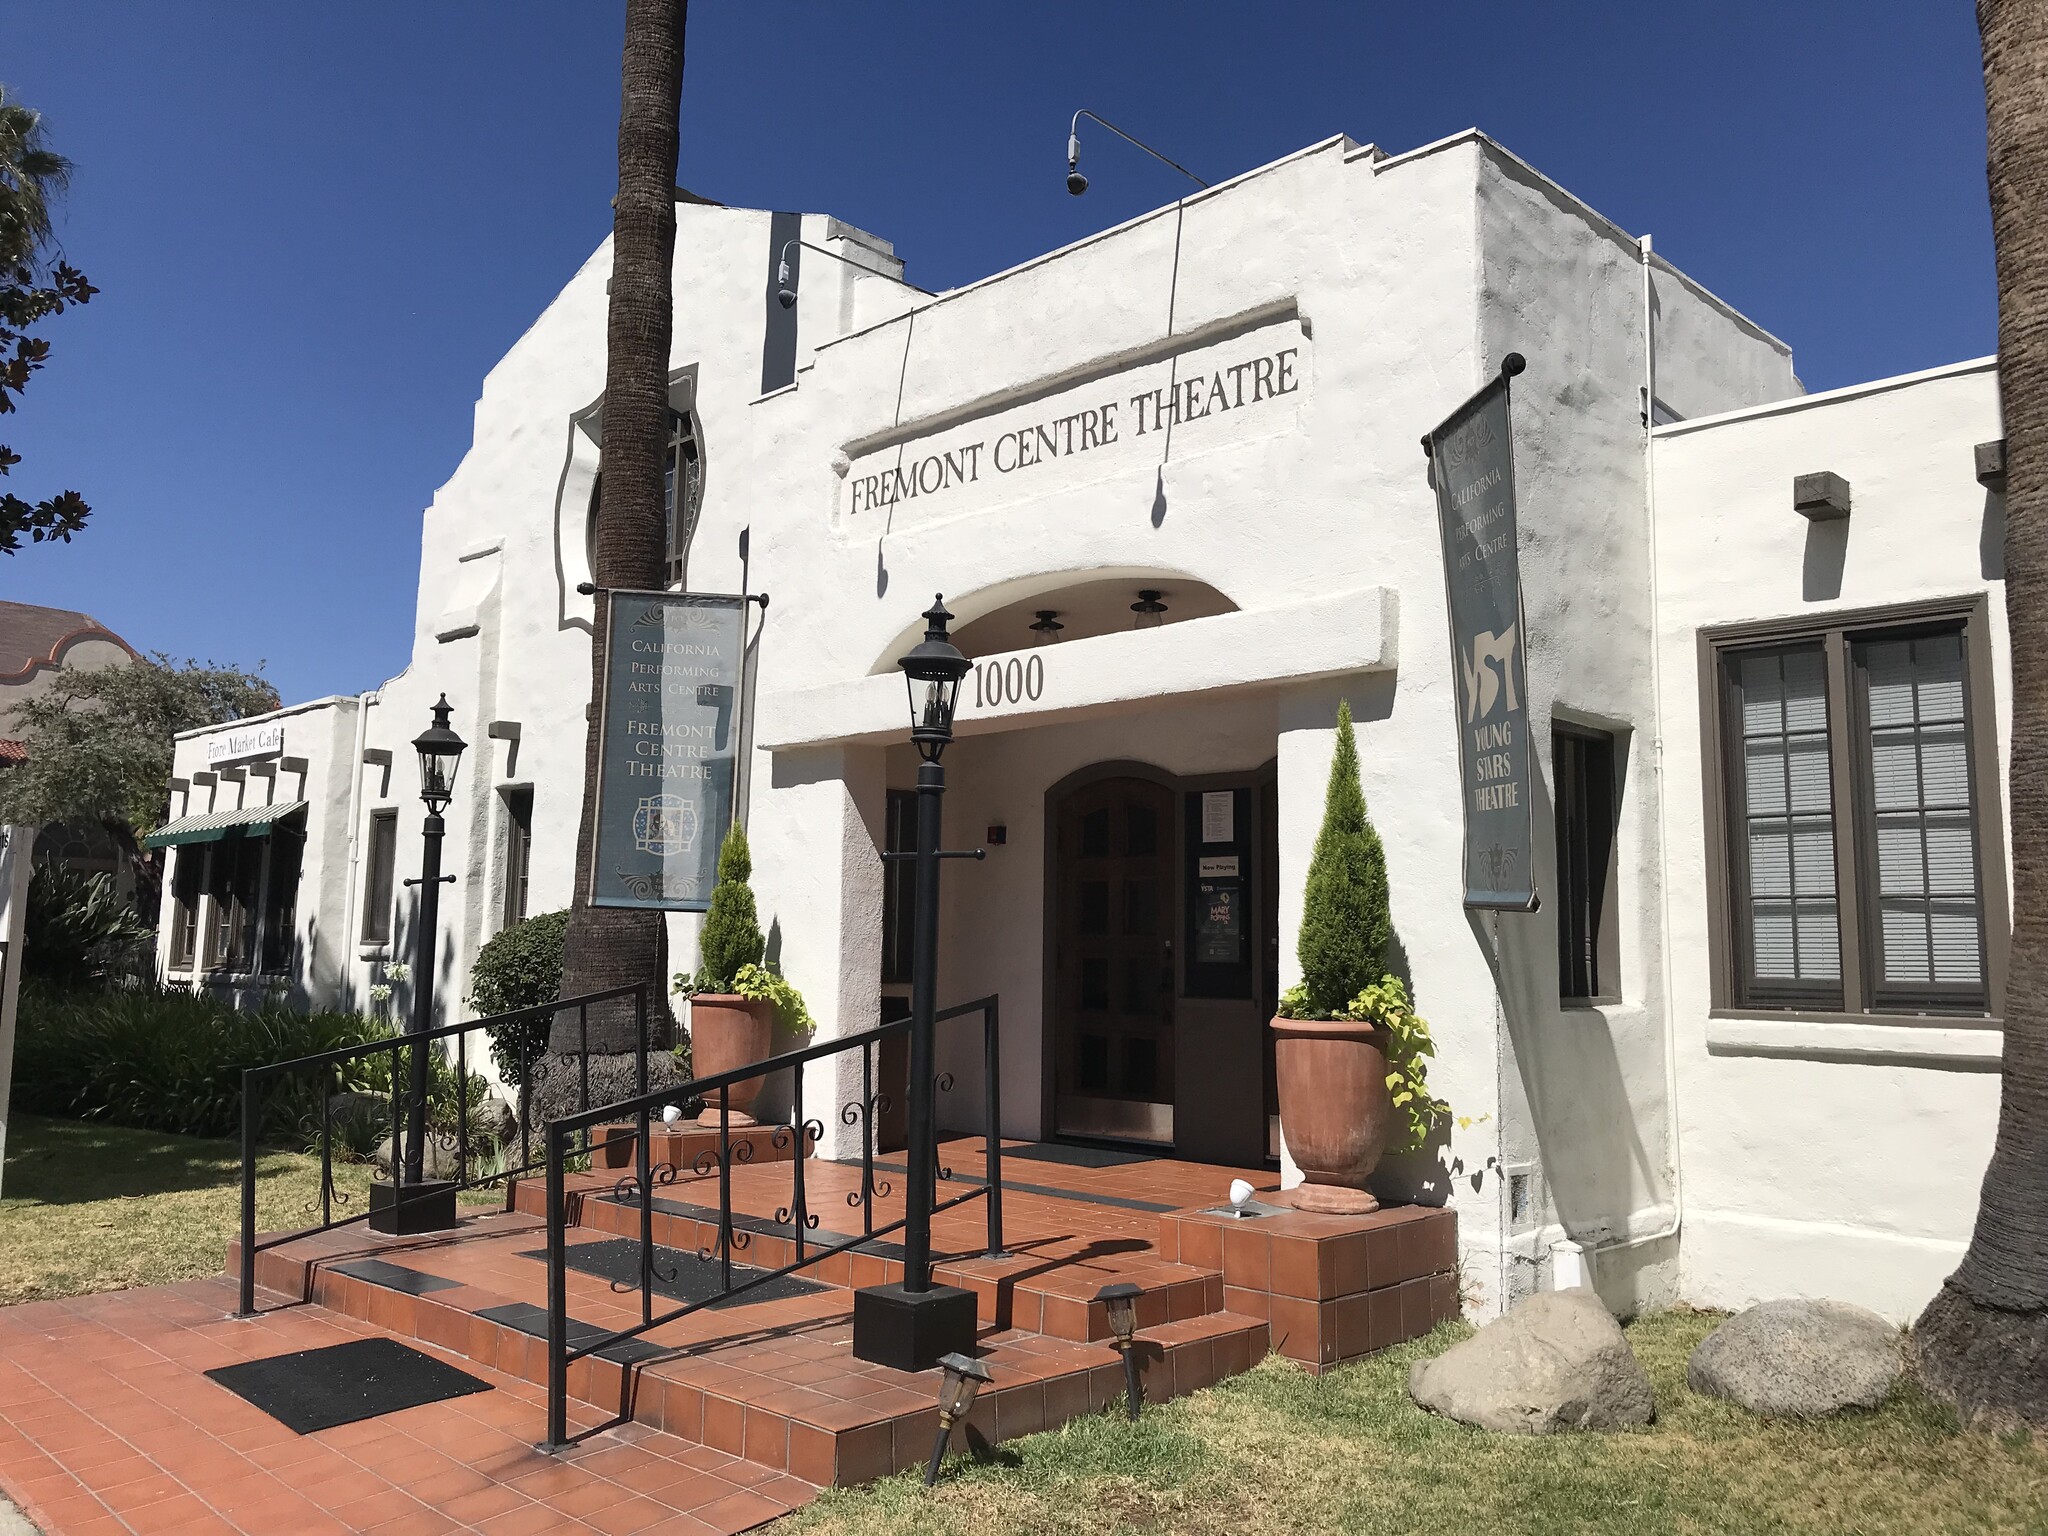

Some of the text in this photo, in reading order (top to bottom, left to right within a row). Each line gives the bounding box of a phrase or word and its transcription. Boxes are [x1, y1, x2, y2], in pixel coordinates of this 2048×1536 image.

[850, 347, 1299, 515] FREMONT CENTRE THEATRE
[1451, 466, 1502, 511] CALIFORNIA
[1455, 501, 1505, 544] PERFORMING
[1475, 533, 1508, 562] CENTRE
[631, 640, 720, 656] CALIFORNIA
[631, 661, 719, 677] PERFORMING
[975, 654, 1044, 708] 1000
[1462, 620, 1520, 724] YST
[628, 681, 719, 696] ARTS CENTRE
[208, 727, 280, 759] Fiore Market Cafe
[627, 720, 716, 738] FREMONT
[1474, 720, 1512, 752] YOUNG
[635, 741, 708, 758] CENTRE
[625, 760, 712, 780] THEATRE
[1476, 752, 1511, 782] STARS
[1474, 781, 1519, 812] THEATRE
